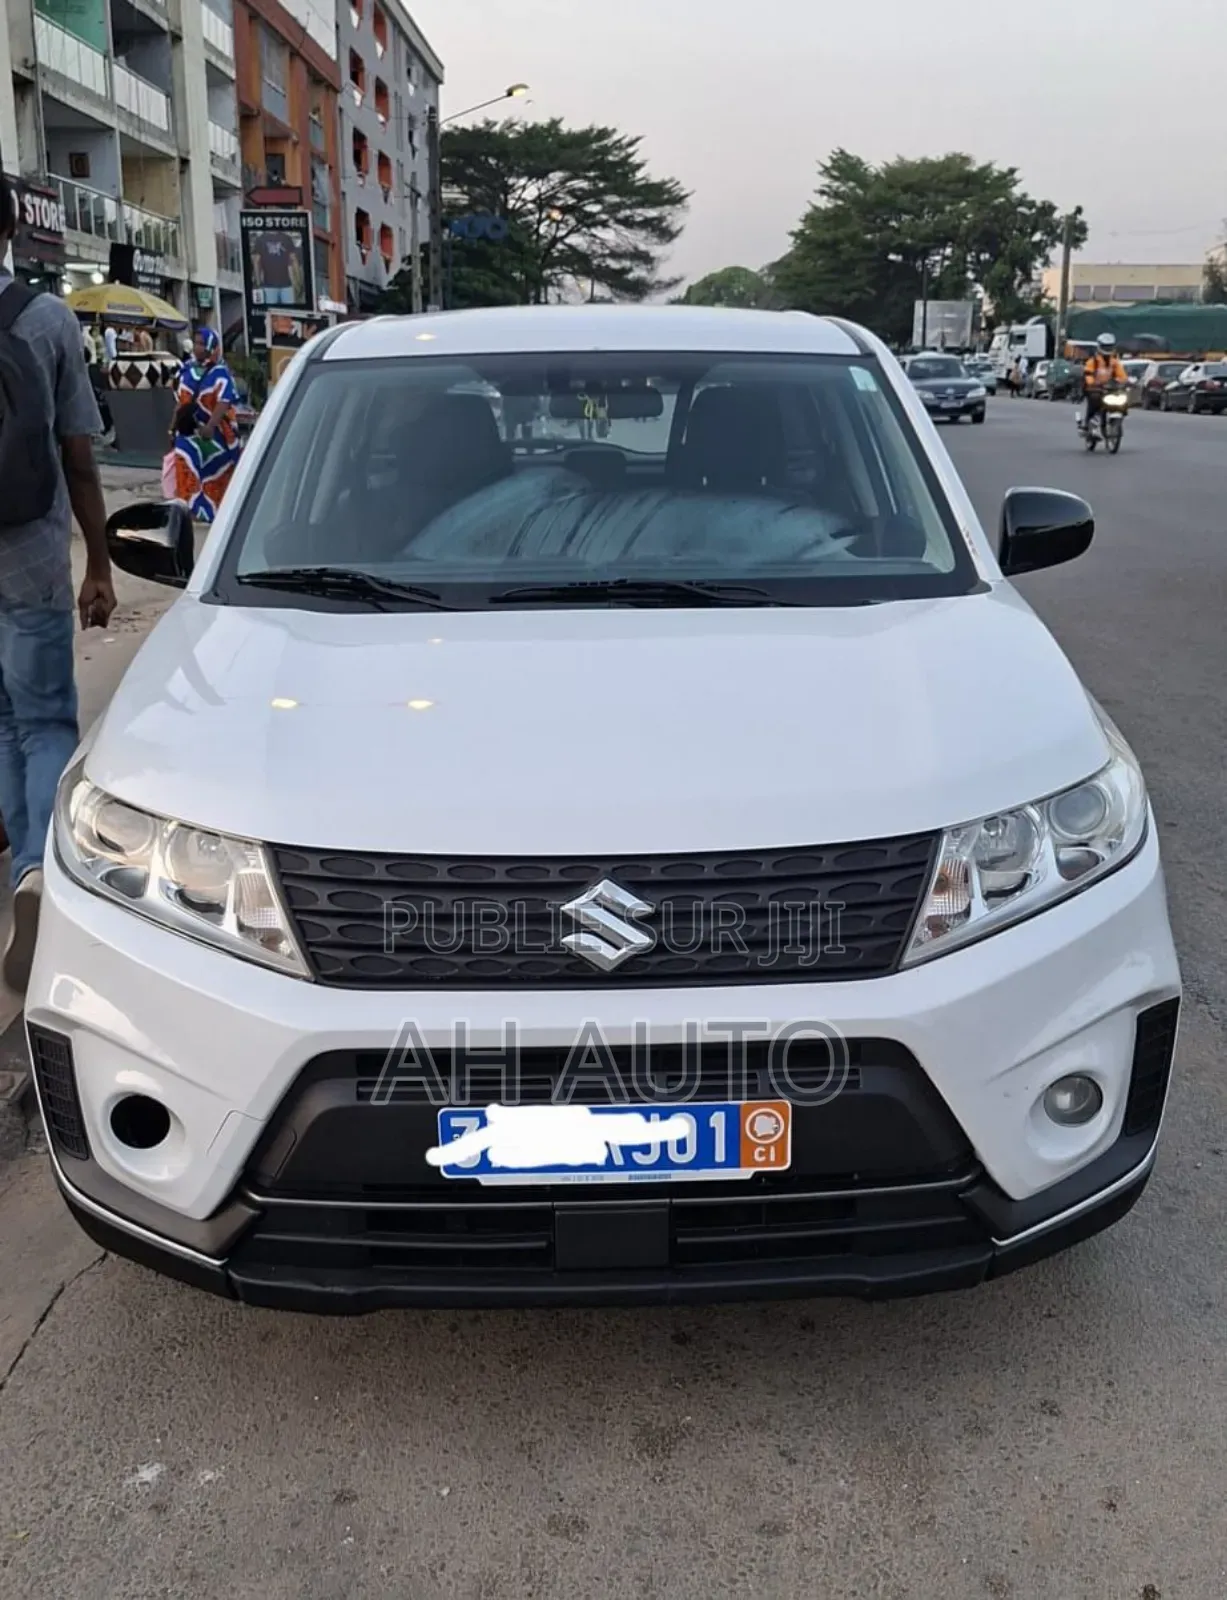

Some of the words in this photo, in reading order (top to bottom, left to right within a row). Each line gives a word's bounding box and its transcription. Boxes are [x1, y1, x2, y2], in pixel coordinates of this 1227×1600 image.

[24, 193, 66, 233] STORE
[242, 216, 264, 228] ISO
[265, 216, 307, 229] STORE
[753, 1145, 776, 1162] CI
